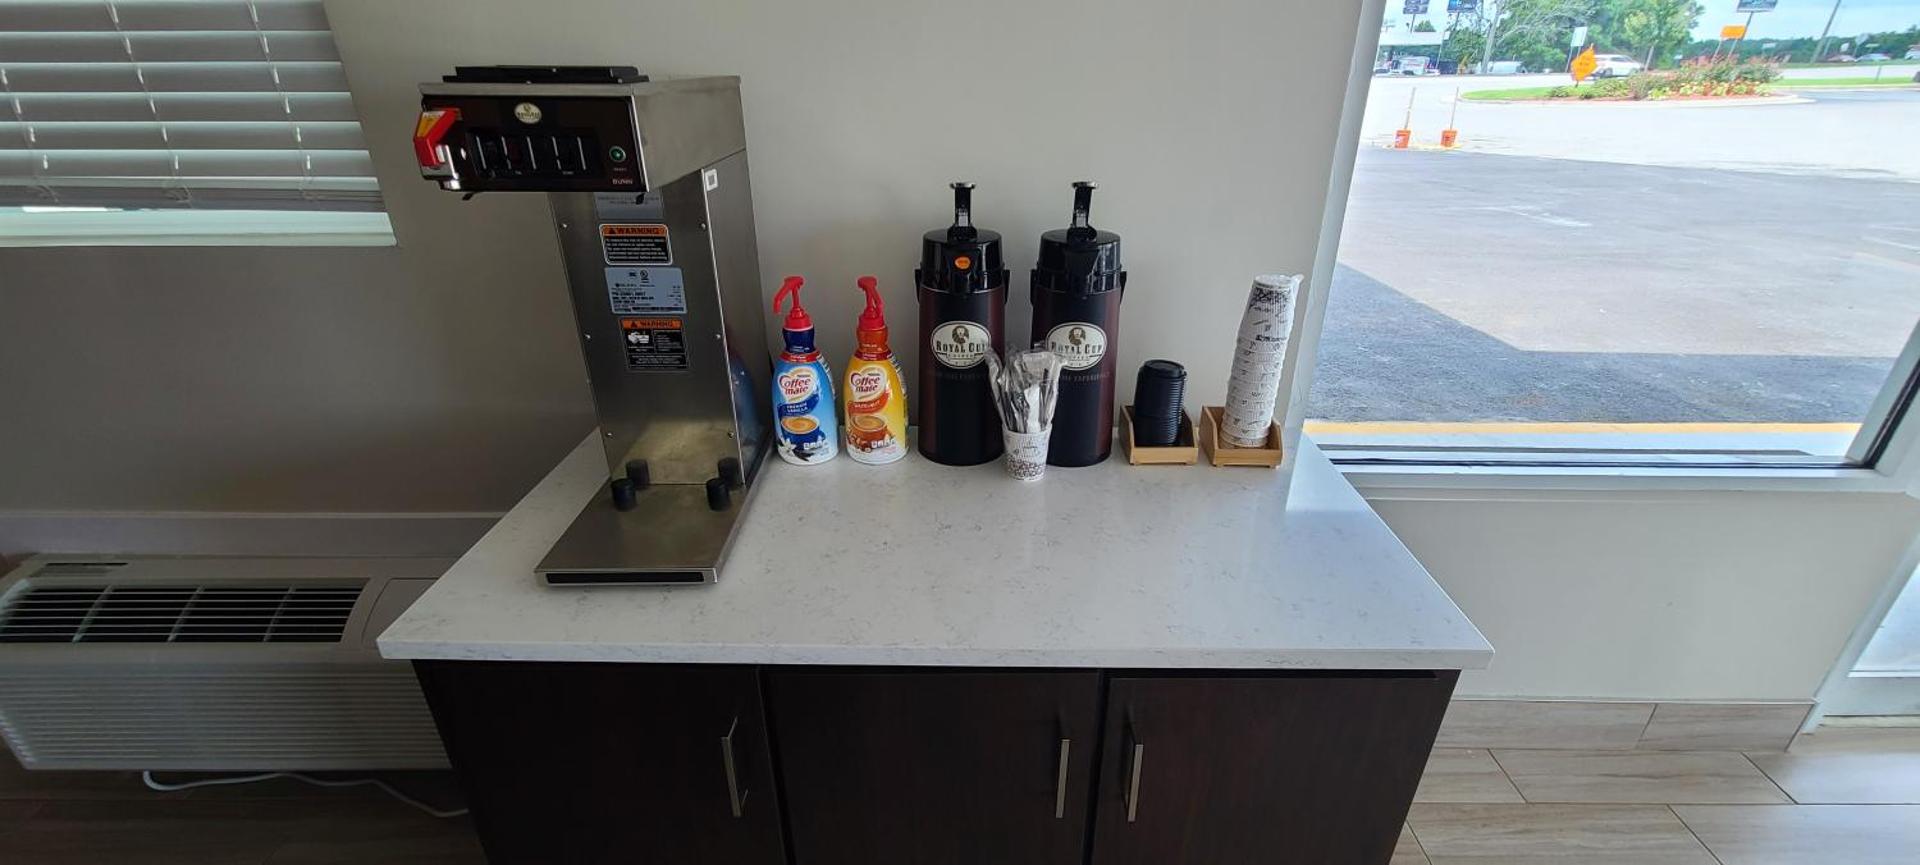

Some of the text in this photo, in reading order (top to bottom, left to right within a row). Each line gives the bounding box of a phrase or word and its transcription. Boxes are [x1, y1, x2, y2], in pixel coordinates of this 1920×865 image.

[616, 227, 660, 235] WARNING
[640, 319, 673, 328] WARNING
[936, 340, 966, 353] ROYAL
[1084, 343, 1103, 354] CUP
[779, 374, 811, 389] Coffee
[850, 372, 881, 386] Coffee
[785, 386, 809, 395] mate
[855, 384, 878, 393] mate
